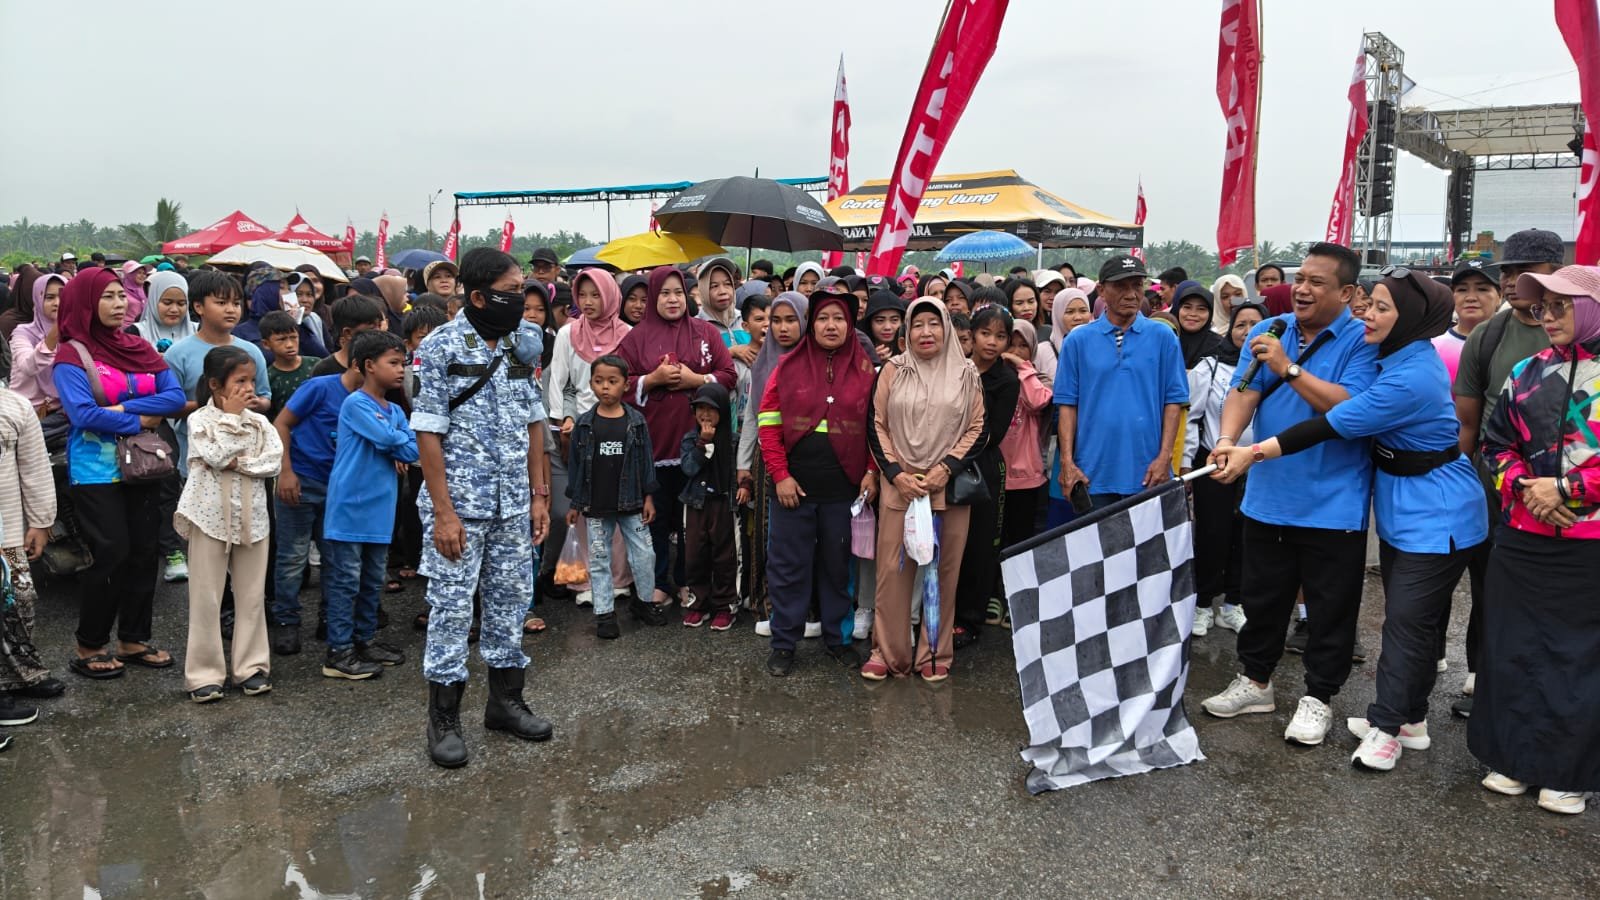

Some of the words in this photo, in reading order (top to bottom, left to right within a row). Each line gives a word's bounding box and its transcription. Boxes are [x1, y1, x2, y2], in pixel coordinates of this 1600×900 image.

[840, 198, 886, 209] Coffe
[600, 441, 623, 449] BOSS
[599, 448, 625, 456] KECIL
